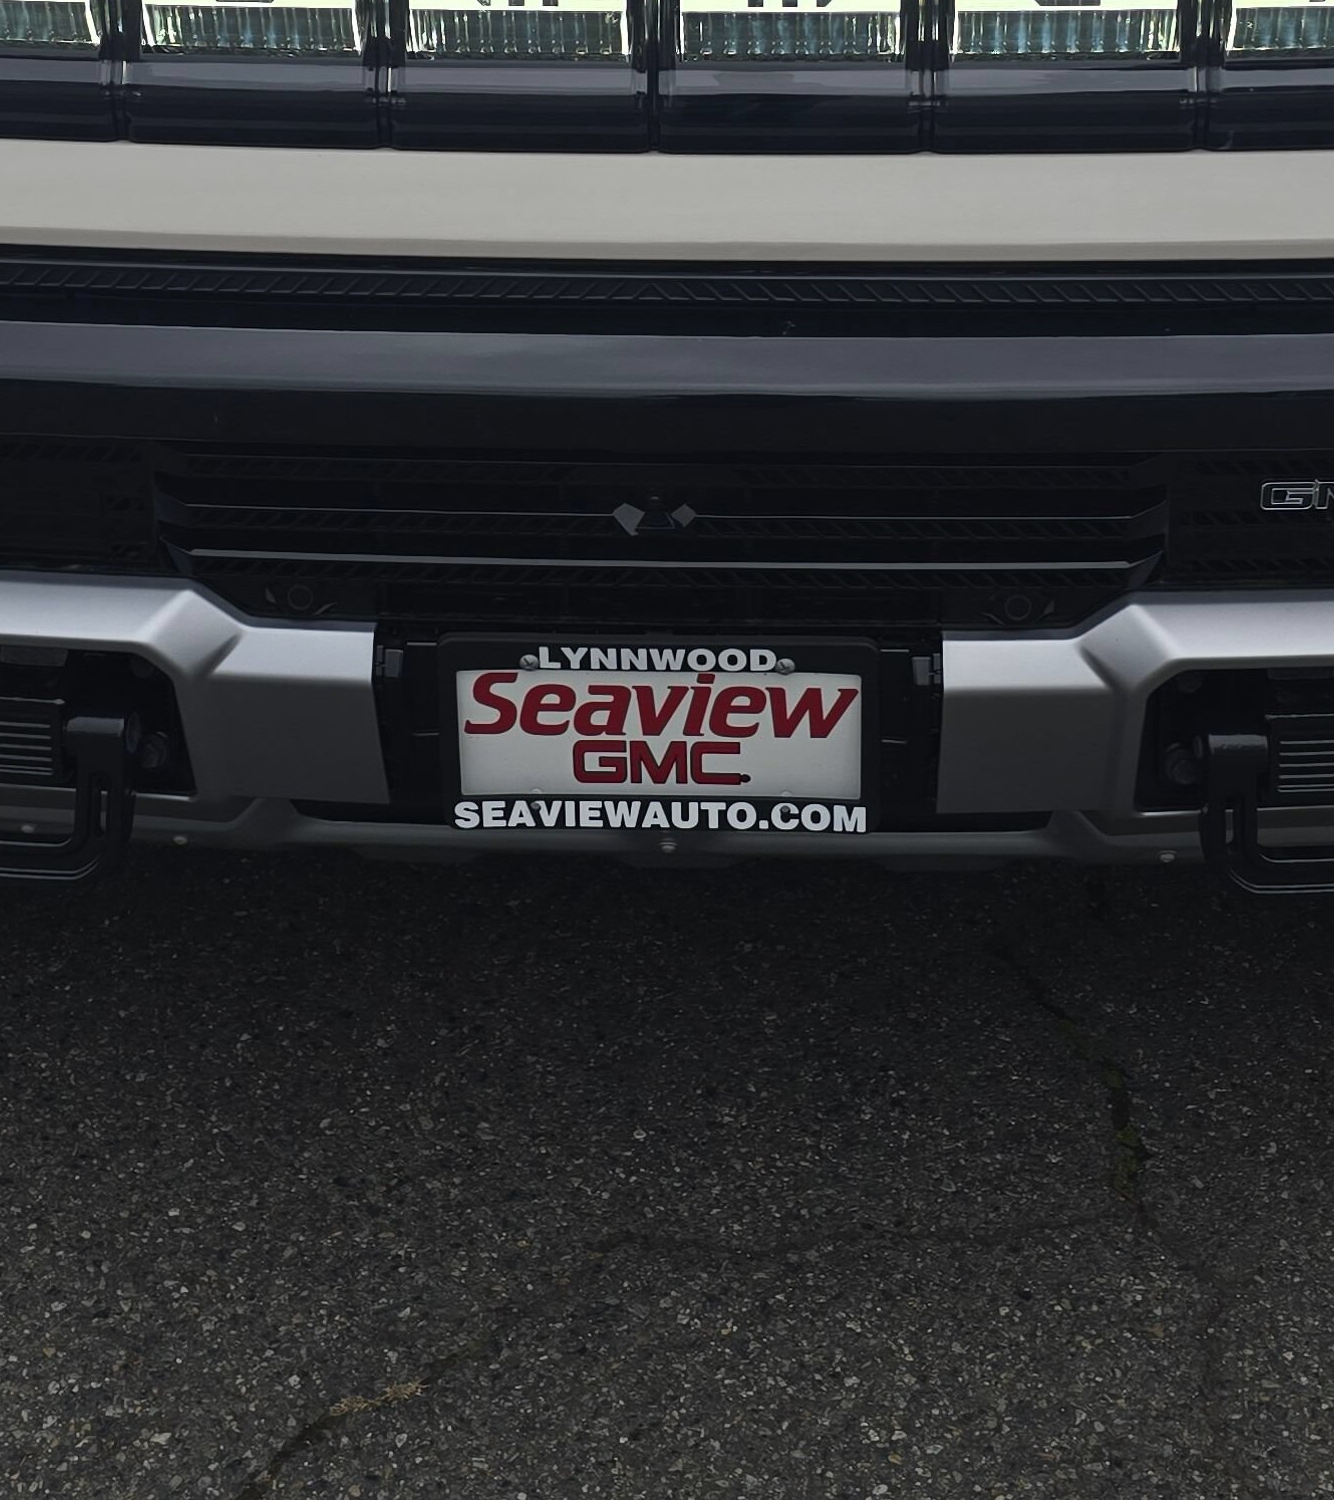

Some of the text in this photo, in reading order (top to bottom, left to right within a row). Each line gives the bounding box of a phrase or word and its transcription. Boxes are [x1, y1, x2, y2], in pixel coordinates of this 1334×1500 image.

[538, 646, 777, 672] LYNNWOOD
[463, 672, 859, 739] Seaview
[573, 740, 743, 786] GMC
[454, 800, 867, 833] SEAVIEWAUTO.COM
